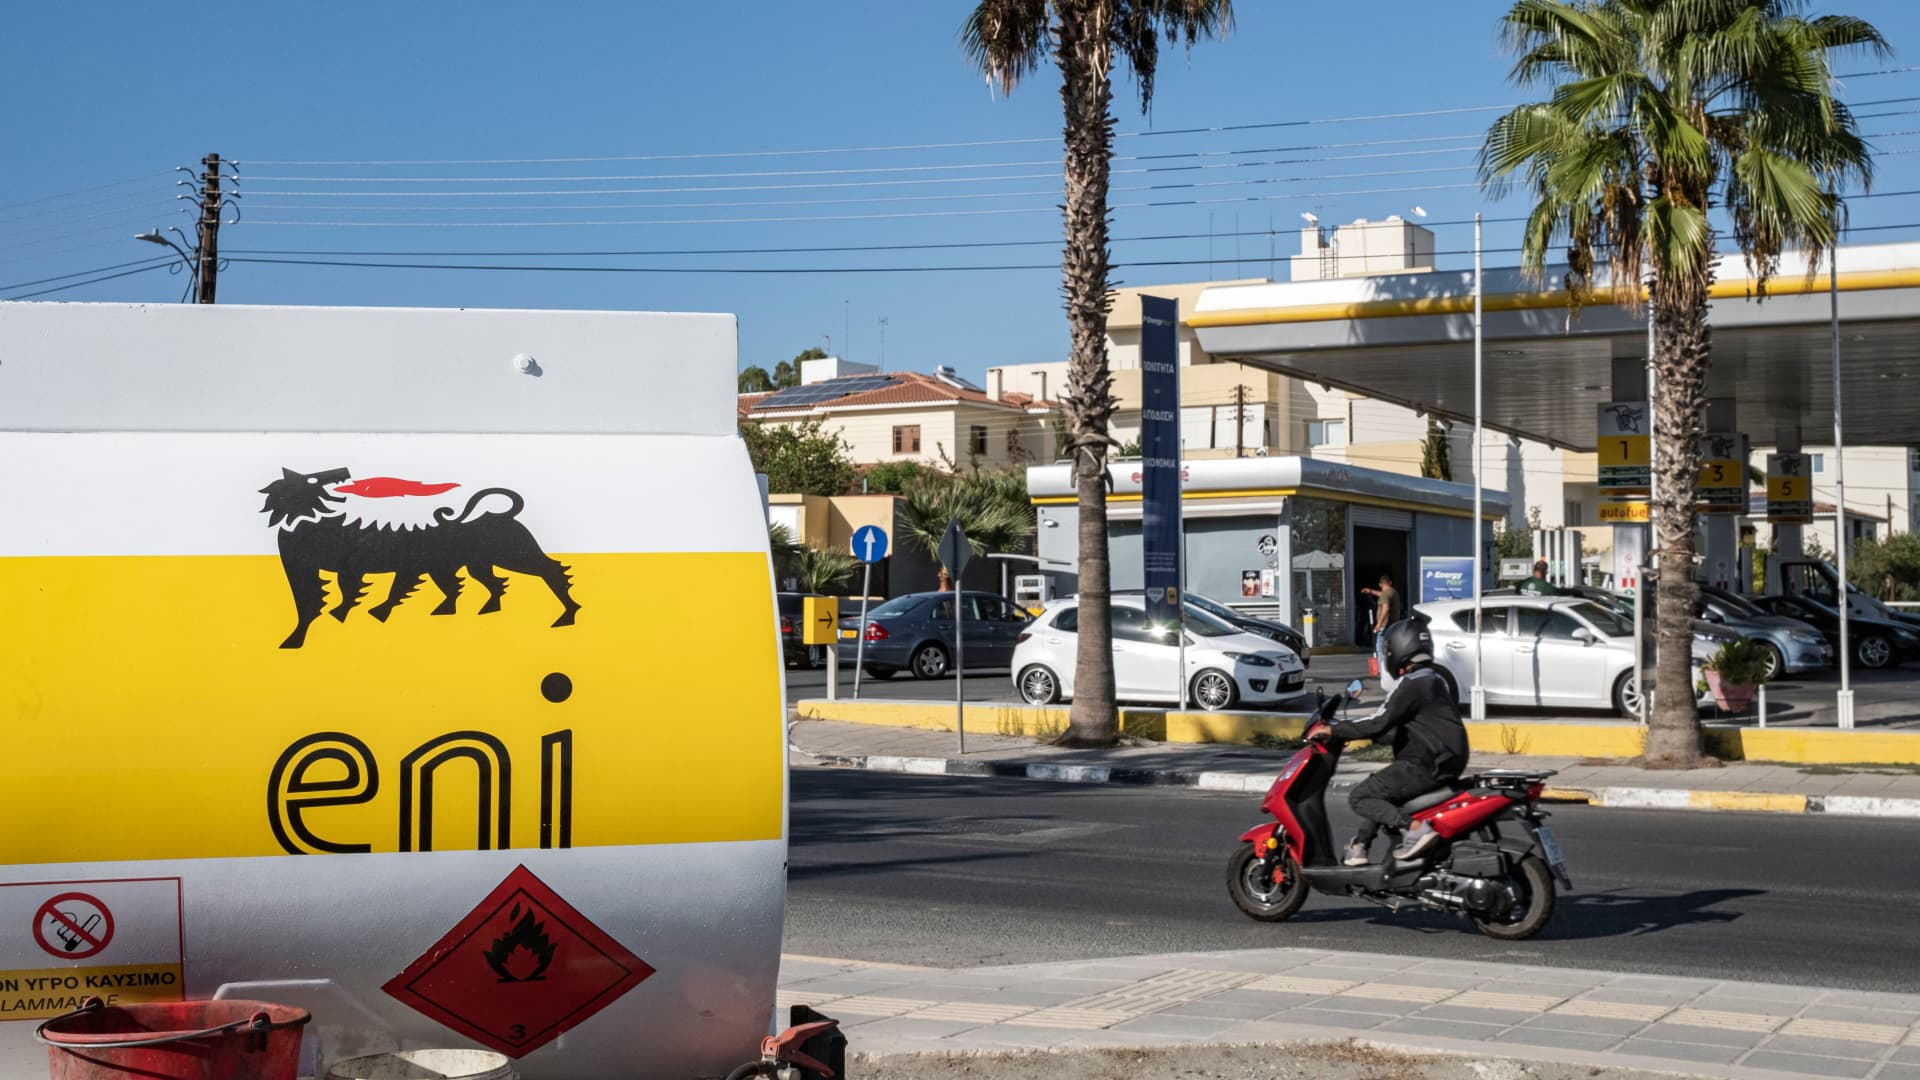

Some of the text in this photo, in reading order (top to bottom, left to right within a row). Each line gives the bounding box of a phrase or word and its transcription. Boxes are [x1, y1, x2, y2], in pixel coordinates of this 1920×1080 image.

[1619, 440, 1628, 461] 1
[1712, 464, 1724, 482] 3
[1782, 481, 1793, 496] 5
[1600, 504, 1651, 519] autofuel
[267, 672, 573, 855] eni
[25, 976, 79, 991] ΥΓΡΟ
[86, 972, 176, 988] ΚΑΥΣΙΜΟ
[1, 994, 119, 1012] LAMMAE
[508, 1024, 527, 1041] 3
